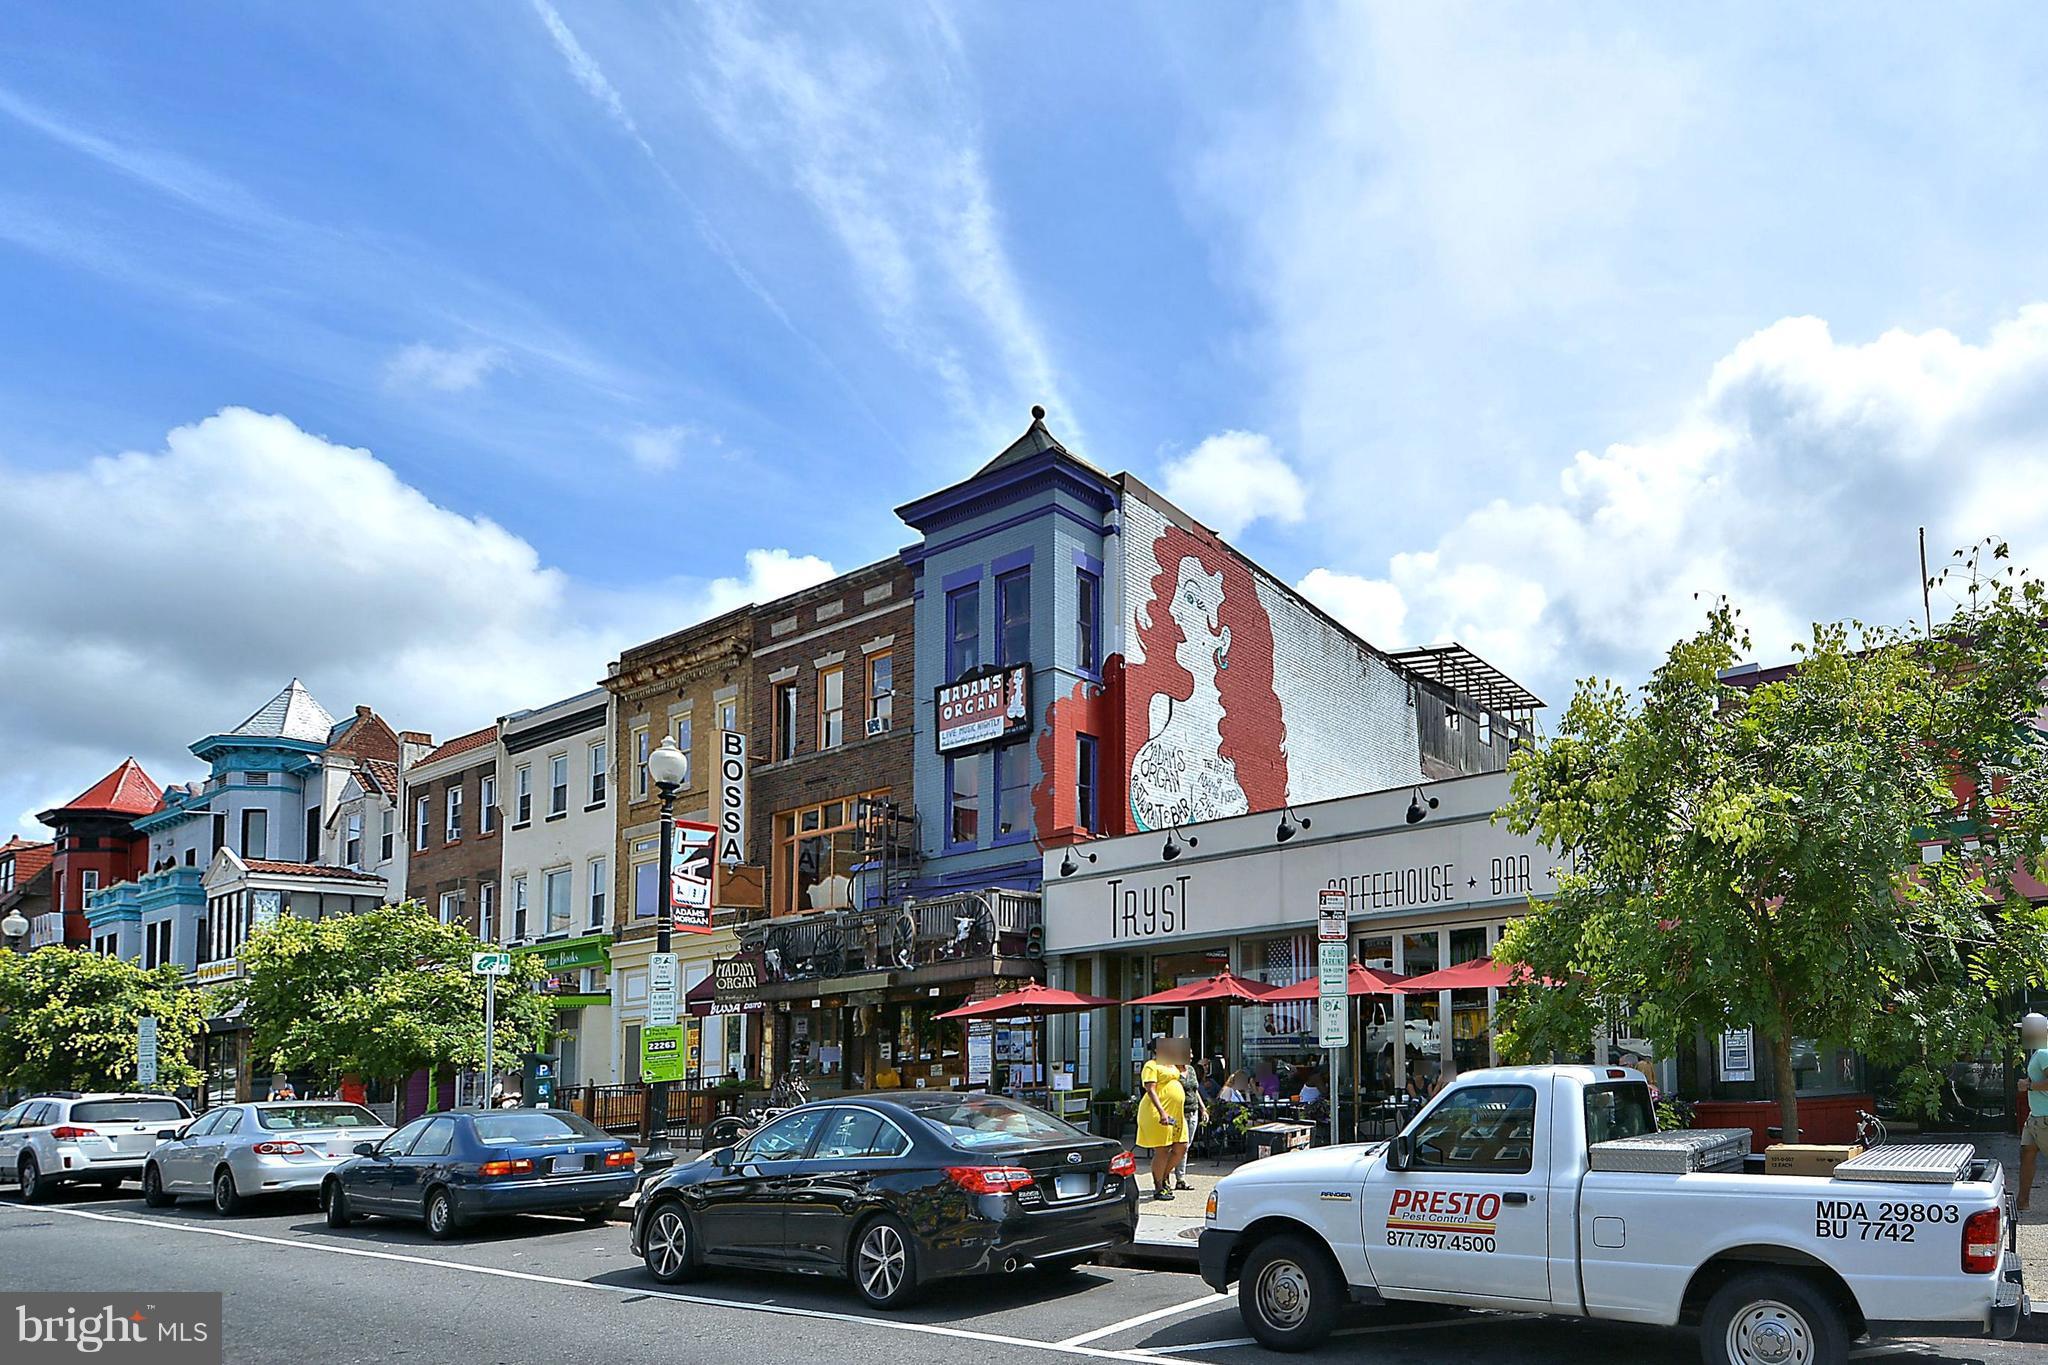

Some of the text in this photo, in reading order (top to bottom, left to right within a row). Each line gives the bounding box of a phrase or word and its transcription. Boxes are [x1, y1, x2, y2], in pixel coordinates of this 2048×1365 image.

[940, 674, 1002, 705] MADAM'S
[943, 693, 998, 720] ORGAN
[942, 729, 957, 740] LIVE
[959, 724, 977, 735] MUSIC
[1141, 759, 1180, 793] ORGAN
[723, 733, 744, 861] BOSSA
[1171, 798, 1190, 825] BAR
[673, 830, 711, 907] EAT
[1328, 863, 1454, 915] FFEEHOUSE
[1490, 854, 1533, 896] BAR
[674, 914, 709, 926] MORGAN
[675, 907, 706, 918] ADAMS
[560, 950, 579, 966] Books
[1321, 958, 1344, 966] PARKING
[1327, 949, 1344, 958] HOUR
[715, 962, 755, 977] MADAM
[716, 976, 757, 990] ORGAN
[648, 1041, 676, 1051] 22263
[1388, 1189, 1501, 1221] PRESTO
[1816, 1200, 1960, 1224] MDA 29803
[1402, 1212, 1468, 1224] Pest Control
[1386, 1230, 1497, 1254] 877.797.4500
[1816, 1220, 1915, 1243] BU 7742
